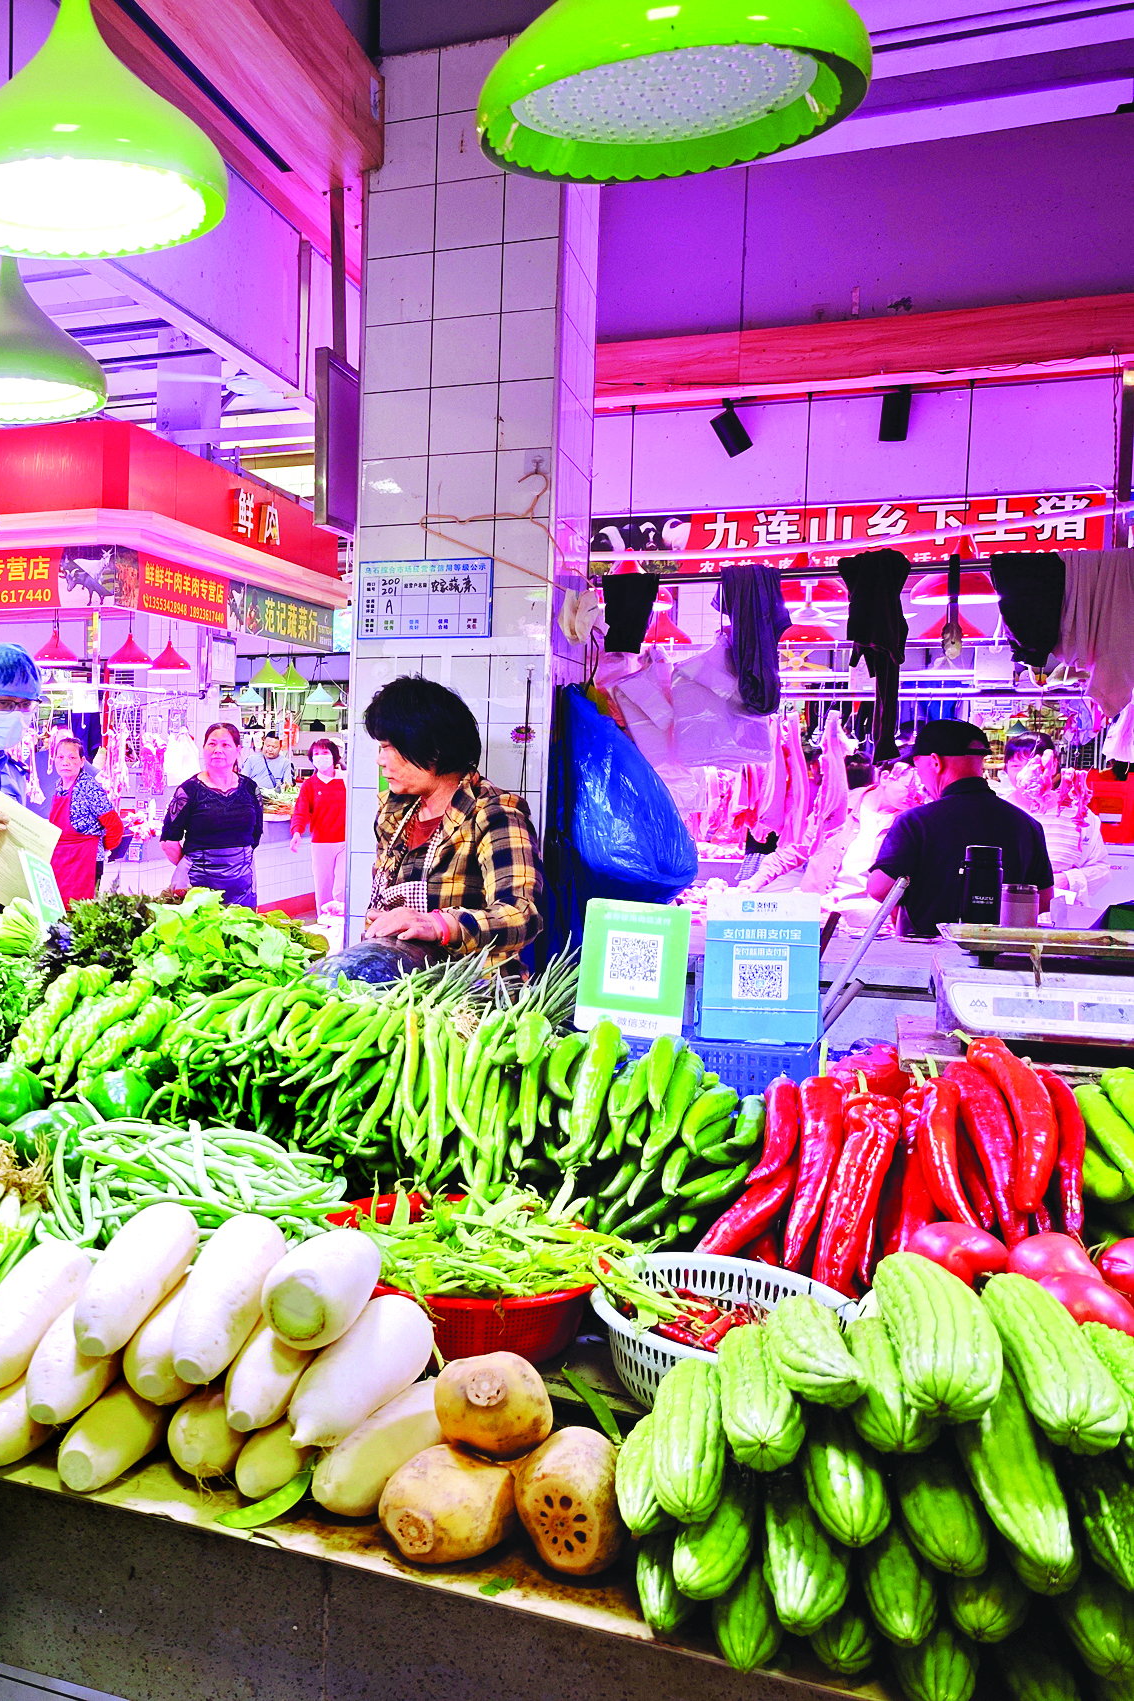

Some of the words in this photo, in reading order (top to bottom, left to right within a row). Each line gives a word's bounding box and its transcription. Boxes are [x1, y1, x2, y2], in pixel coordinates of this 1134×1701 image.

[237, 488, 280, 546] 鲜肉
[703, 495, 1094, 552] 九连山乡下土猪
[144, 561, 224, 604] 鲜鲜牛肉羊肉专营店
[382, 577, 400, 587] 200
[382, 586, 397, 596] 201
[385, 599, 393, 614] A
[264, 596, 318, 643] 范记蔬菜行
[723, 928, 802, 940] 支付就用支付宝
[617, 1016, 658, 1031] 微信支付
